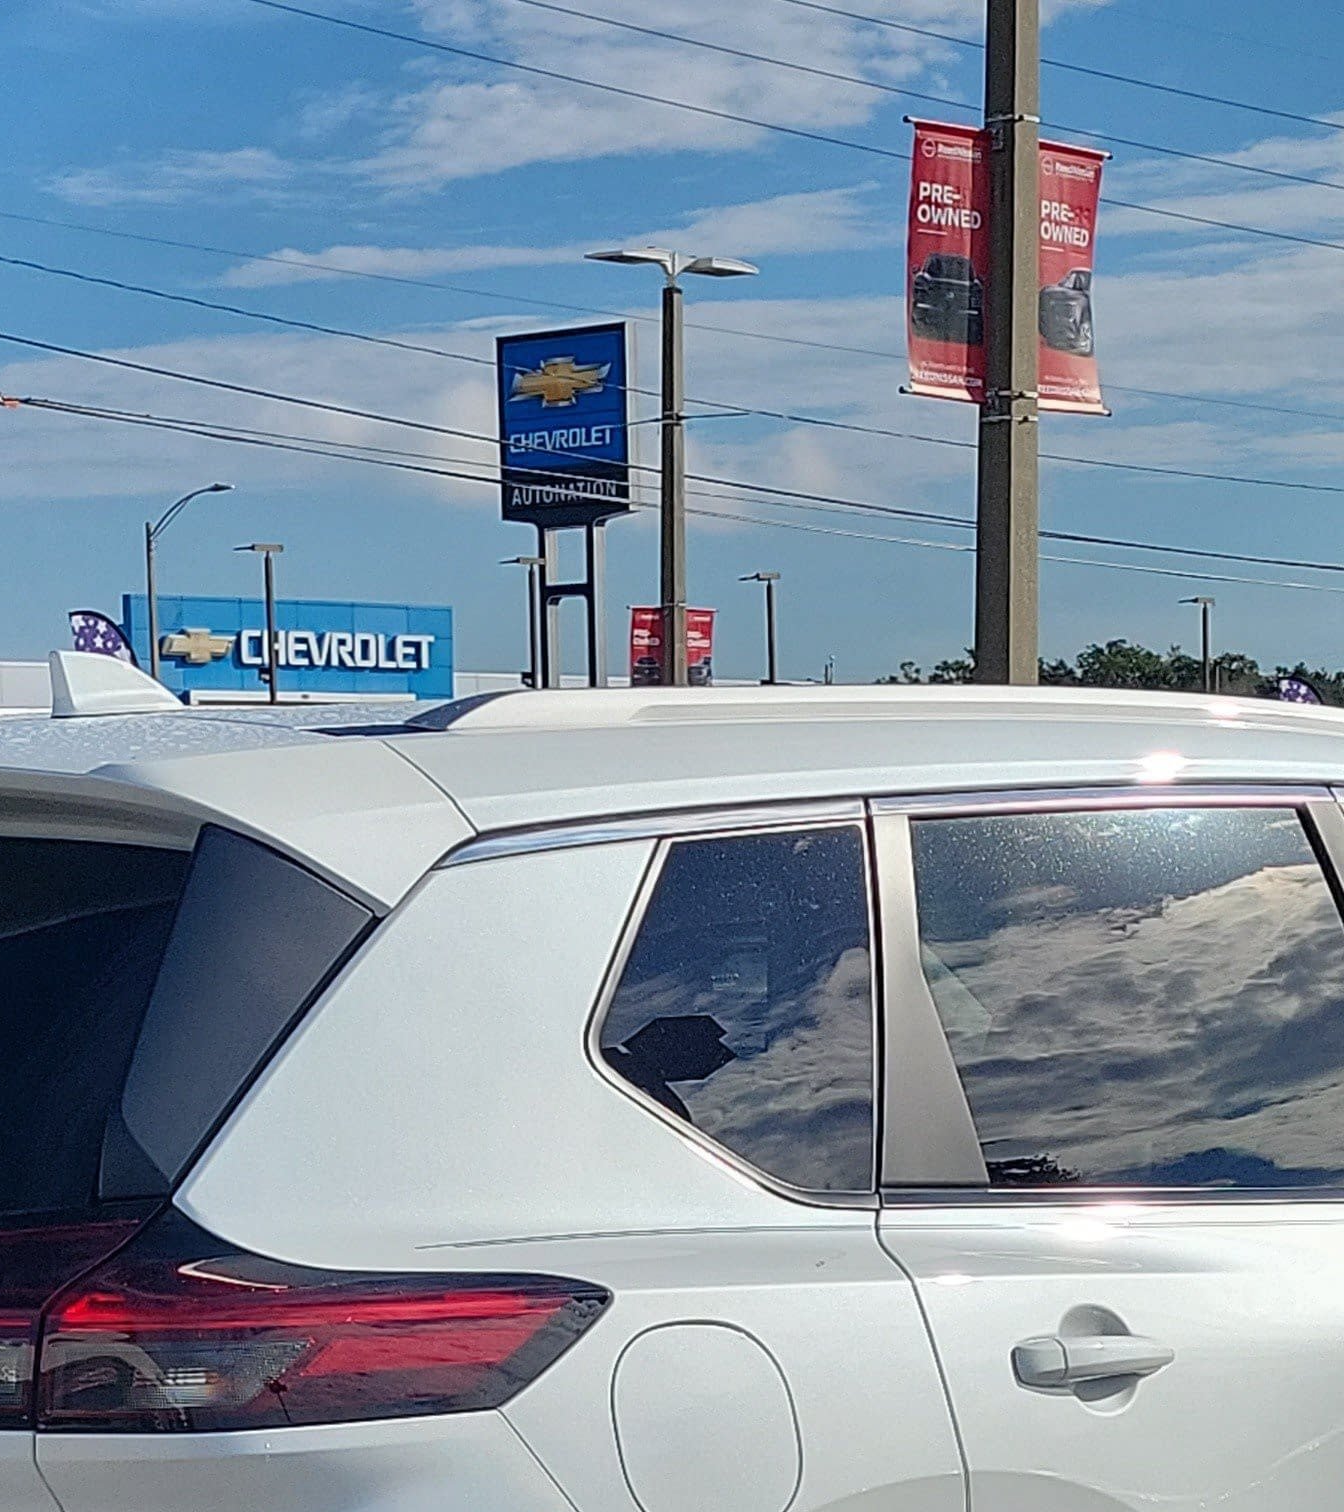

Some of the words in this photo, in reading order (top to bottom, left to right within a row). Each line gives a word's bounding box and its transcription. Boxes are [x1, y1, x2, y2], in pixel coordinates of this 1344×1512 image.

[919, 181, 961, 204] PRE-
[917, 203, 982, 229] OWNED
[1041, 199, 1075, 222] PRE-
[1040, 220, 1089, 247] OWNED
[509, 426, 611, 453] CHEVROLET
[511, 480, 617, 506] AUTONATION
[240, 629, 435, 669] CHEVROLET
